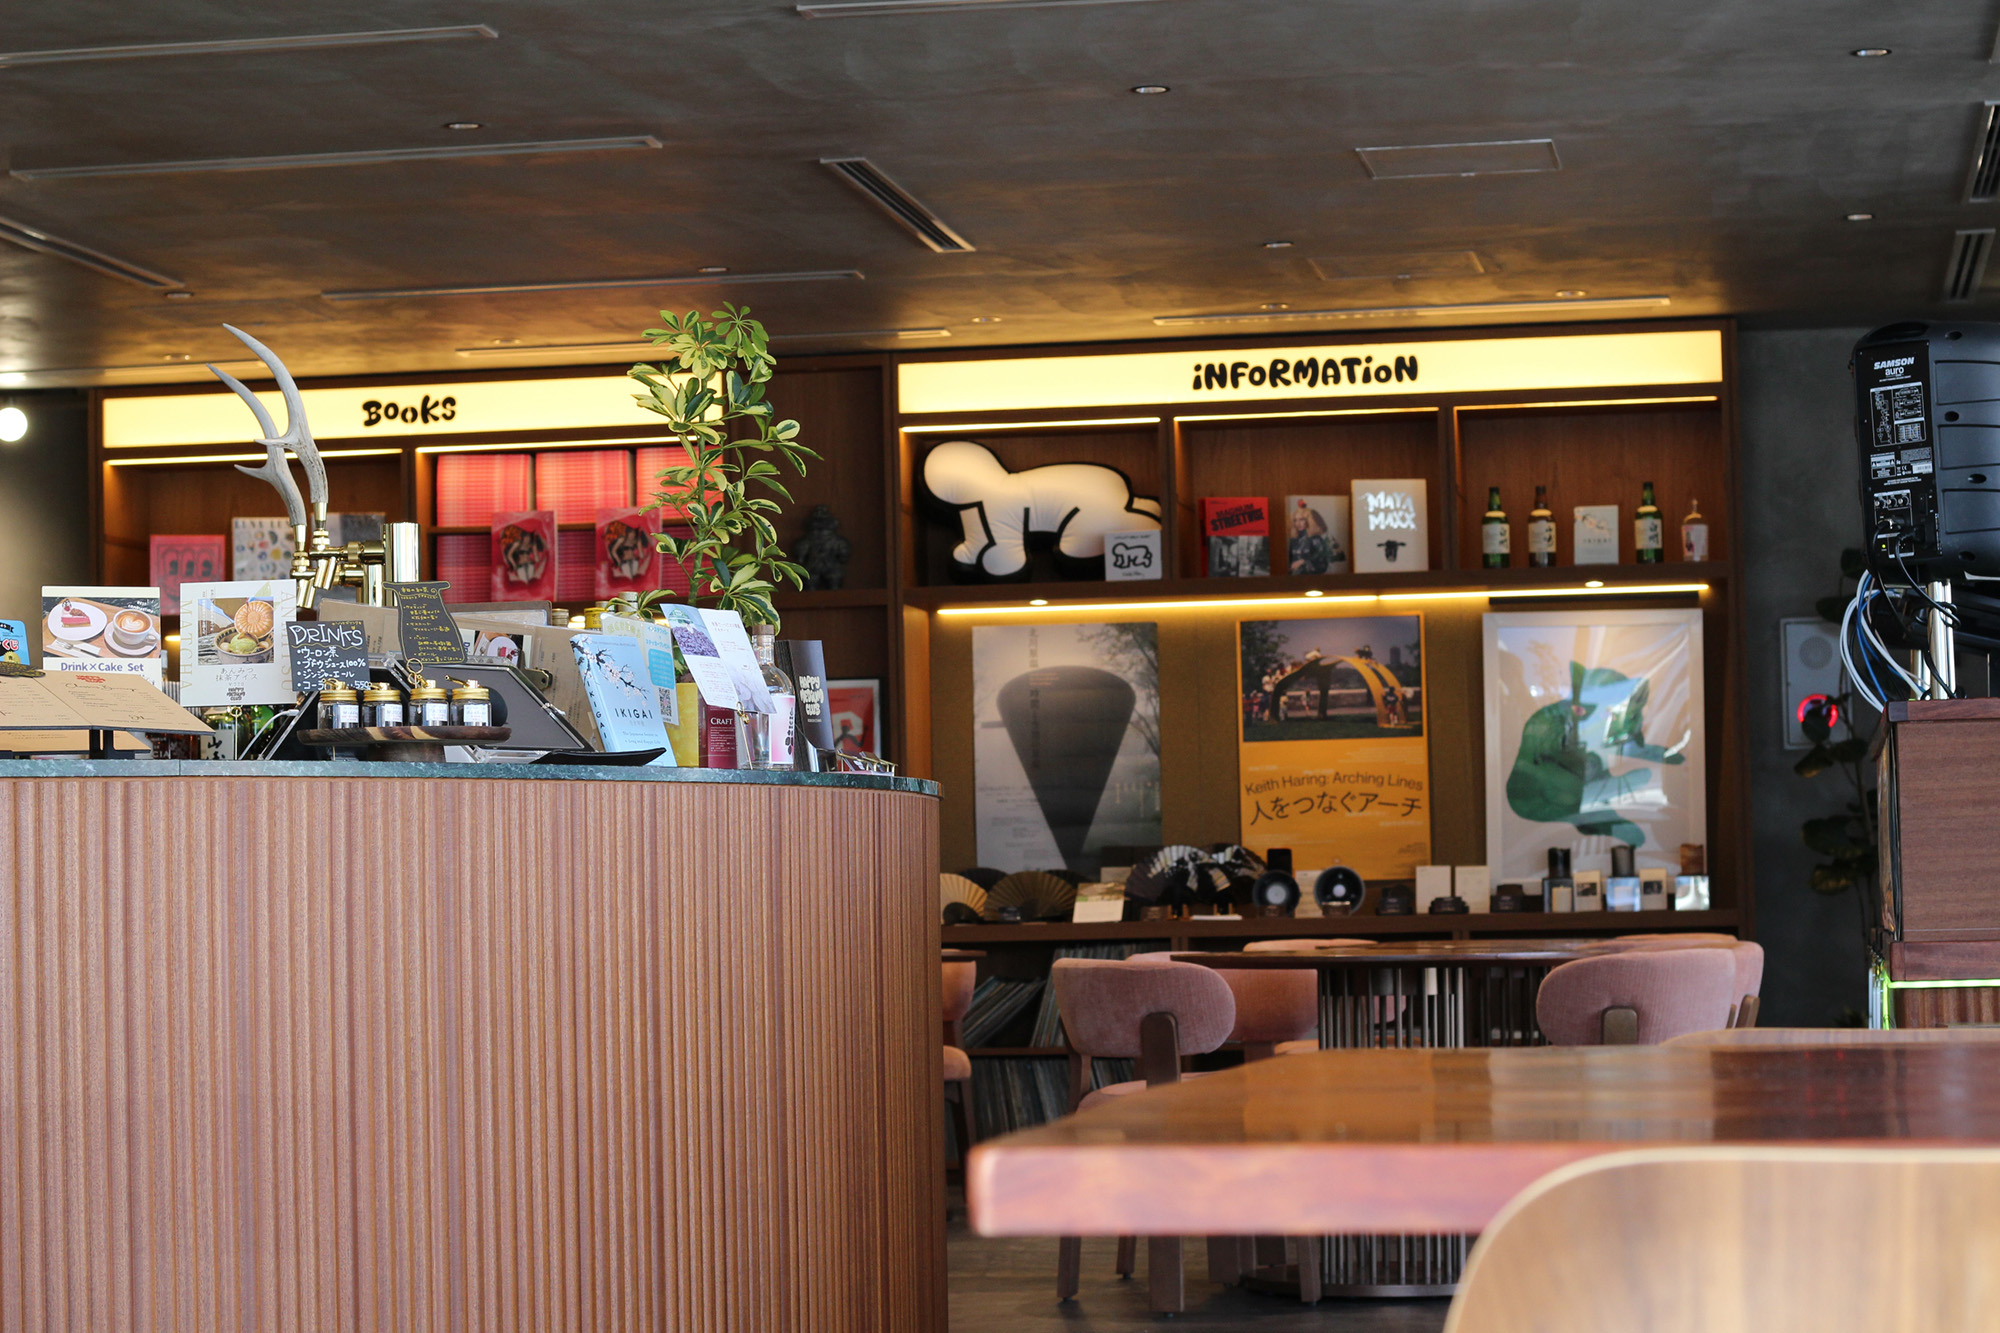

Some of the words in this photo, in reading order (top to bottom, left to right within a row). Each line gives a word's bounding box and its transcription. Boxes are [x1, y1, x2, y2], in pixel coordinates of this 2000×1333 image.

[1873, 357, 1915, 370] SAMSON
[1885, 366, 1904, 376] auro
[1366, 490, 1414, 512] MAYA
[1368, 512, 1417, 531] MAXX
[180, 599, 192, 690] MATCHA
[289, 624, 363, 647] DRINKS
[127, 662, 144, 672] Set
[587, 680, 607, 739] IKIGAI
[614, 707, 653, 720] IKIGAI
[710, 717, 733, 725] CRAFT
[1245, 779, 1280, 796] Keith
[1282, 773, 1330, 788] Haring:
[1333, 771, 1385, 788] Arching
[1388, 774, 1424, 791] Lines
[1250, 791, 1422, 826] 人をつなぐアーチ
